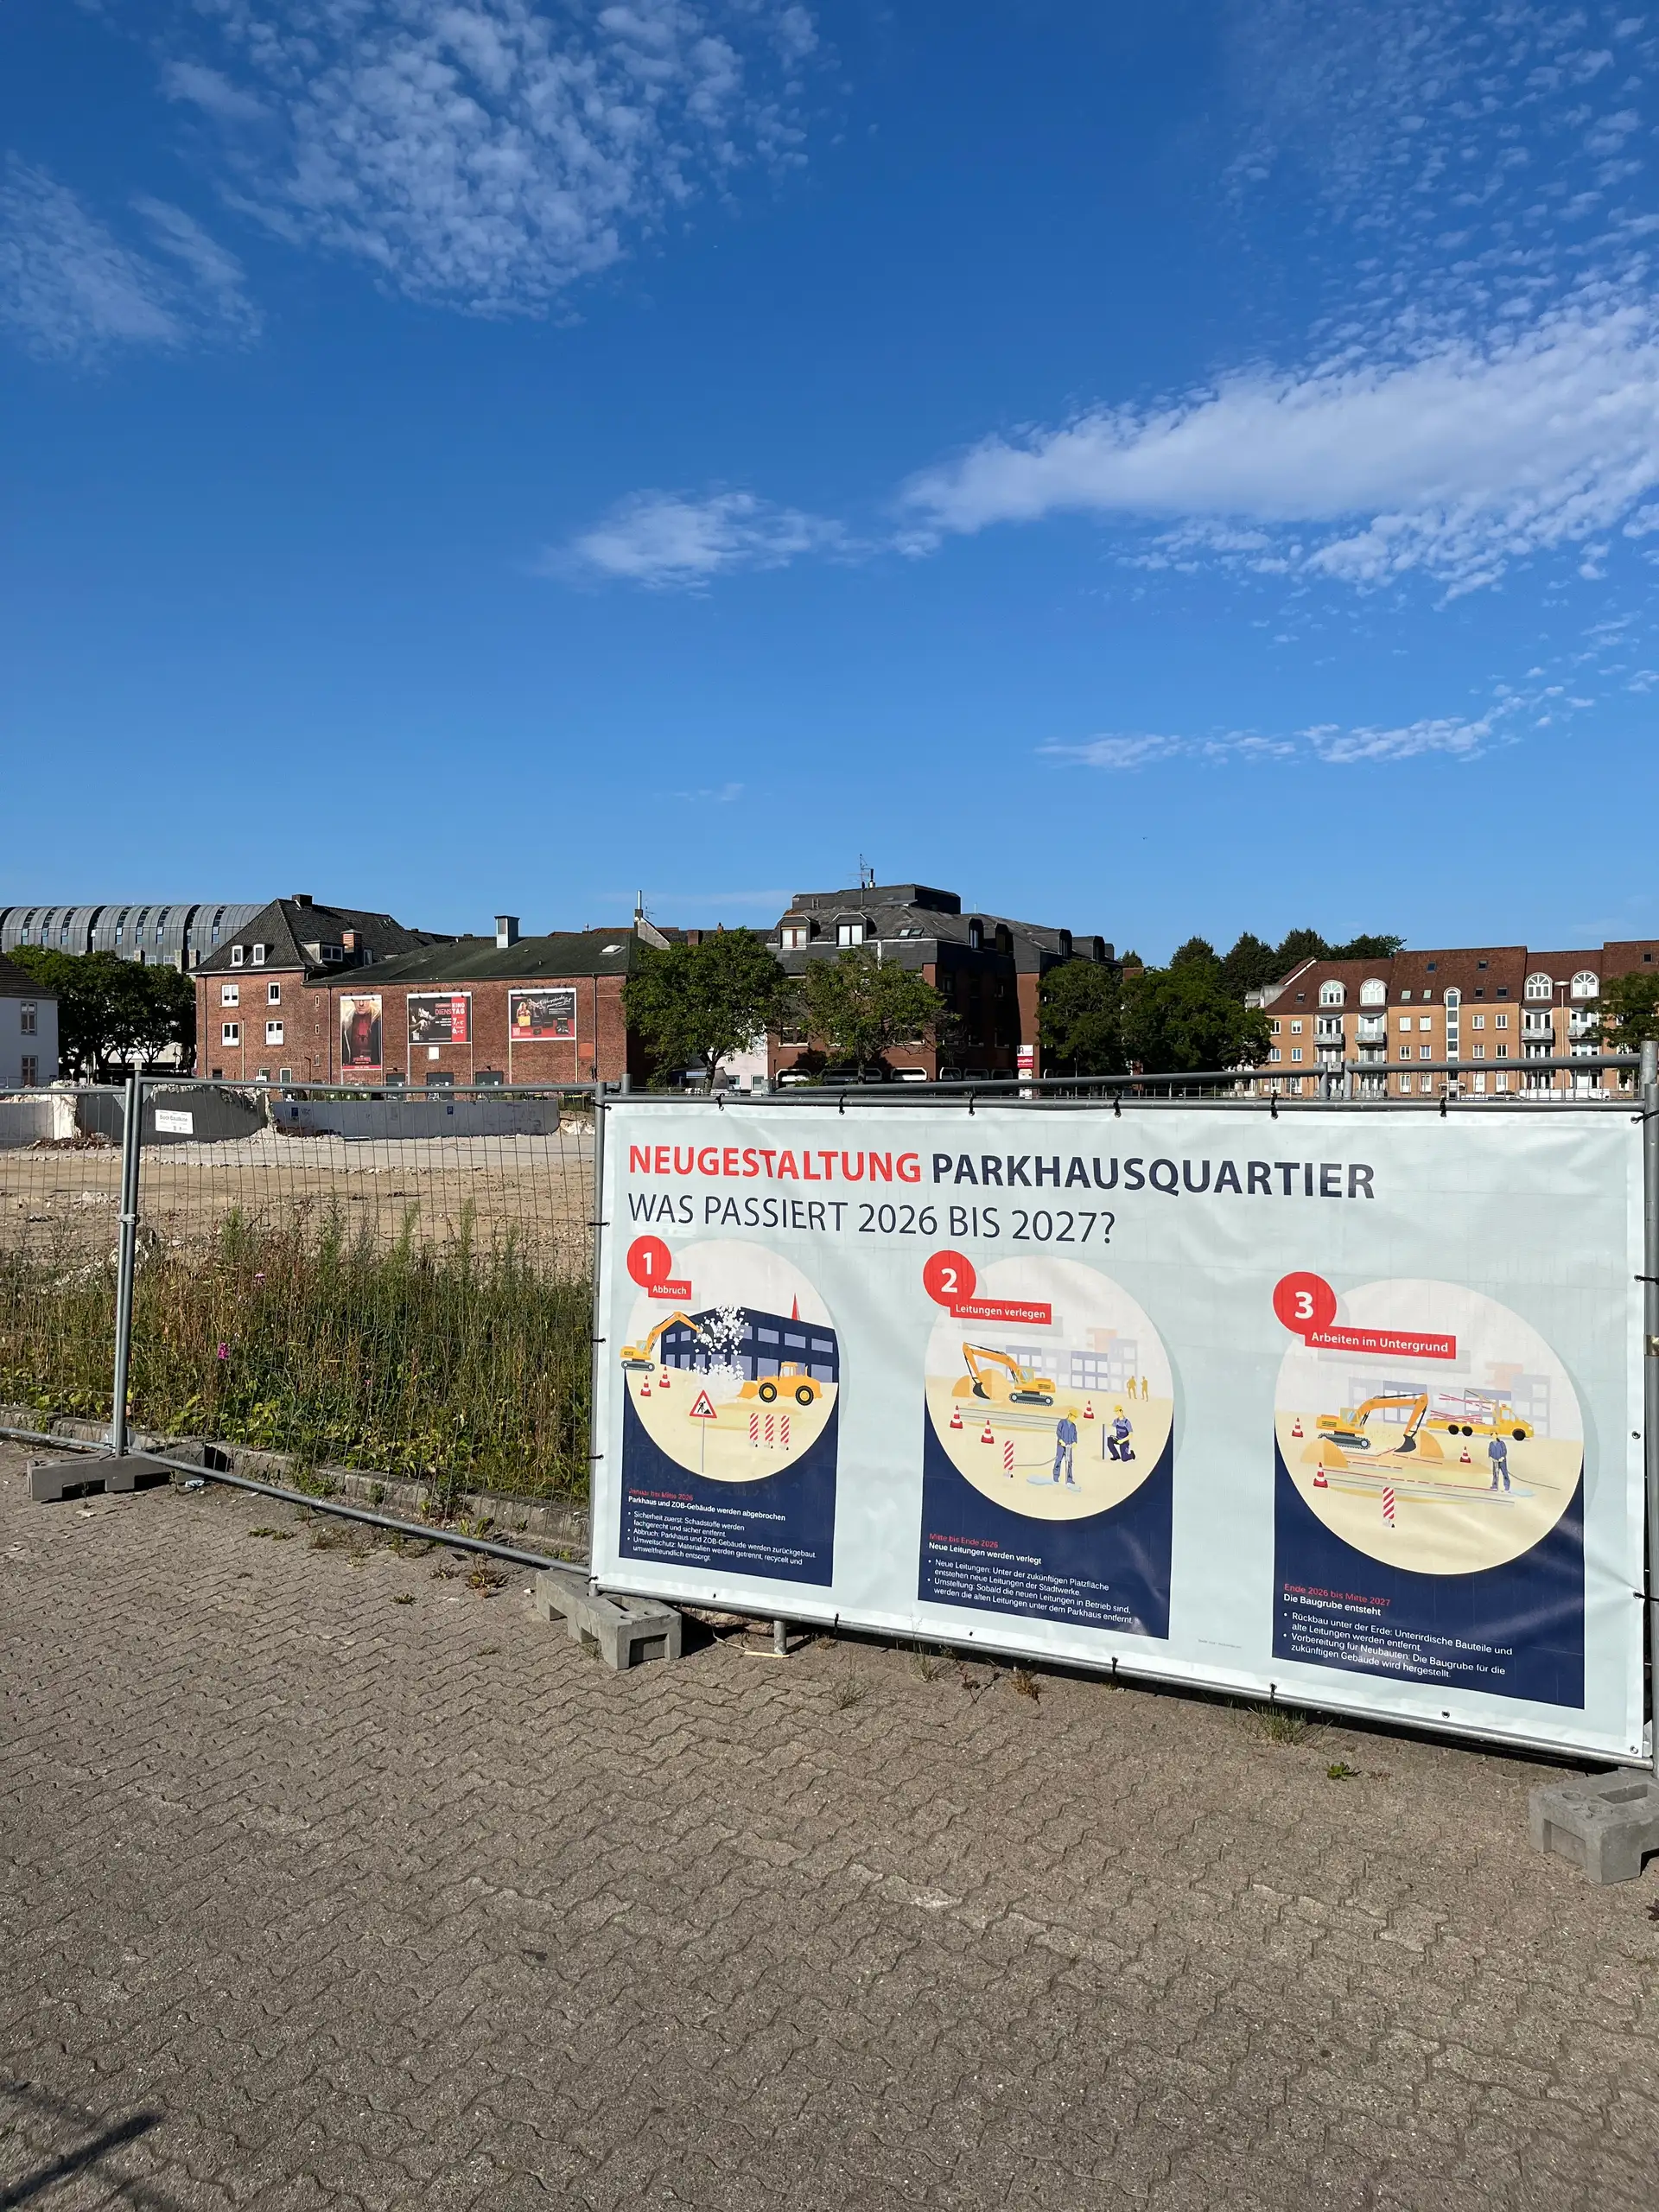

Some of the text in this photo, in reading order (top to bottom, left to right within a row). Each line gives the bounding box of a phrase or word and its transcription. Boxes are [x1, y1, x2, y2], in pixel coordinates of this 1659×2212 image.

[629, 1145, 1375, 1199] NEUGESTALTUNG PARKHAUSQUARTIER
[627, 1192, 693, 1224] WAS
[704, 1196, 849, 1231] PASSIERT
[858, 1203, 938, 1236] 2026
[950, 1205, 1001, 1238] BIS
[1011, 1209, 1116, 1244] 2027?
[643, 1251, 652, 1275] 1
[652, 1285, 687, 1294] Abbruch
[941, 1268, 957, 1294] 2
[956, 1304, 1046, 1320] Leitungen verlegen
[1294, 1291, 1313, 1319] 3
[1311, 1331, 1448, 1355] Arbeiten im Untergrund
[628, 1496, 657, 1505] Parkhaus
[671, 1502, 715, 1512] ZOB-Gebäude
[717, 1507, 741, 1516] werden
[743, 1510, 786, 1521] abgebrochen
[634, 1511, 663, 1521] Sicherheit
[684, 1517, 721, 1528] Schadstoffe
[721, 1522, 745, 1531] werden
[634, 1519, 669, 1529] fachgerecht
[632, 1546, 684, 1557] umweltfreundlich
[633, 1528, 660, 1536] Abbruch:
[660, 1531, 690, 1541] Parkhaus
[703, 1537, 747, 1548] ZOB-Gebäude
[748, 1543, 771, 1552] werden
[930, 1533, 947, 1541] Mitte
[982, 1540, 999, 1548] 2026
[677, 1542, 710, 1552] Materialien
[712, 1547, 734, 1555] werden
[764, 1554, 788, 1563] recycelt
[929, 1541, 1042, 1566] Neue Leitungen werden verlegt
[935, 1559, 954, 1567] Neue
[956, 1562, 991, 1573] Leitungen:
[992, 1567, 1012, 1576] Unter
[1027, 1573, 1068, 1585] zukünftigen
[1070, 1578, 1109, 1591] Platzfläche
[935, 1569, 969, 1580] entstehen
[989, 1576, 1025, 1588] Leitungen
[1026, 1581, 1037, 1590] der
[933, 1588, 960, 1597] werden
[973, 1593, 991, 1602] alten
[992, 1595, 1027, 1607] Leitungen
[1028, 1602, 1047, 1611] unter
[1067, 1607, 1101, 1619] Parkhaus
[976, 1584, 1001, 1593] Sobald
[1039, 1593, 1075, 1605] Leitungen
[1085, 1600, 1111, 1611] Betrieb
[1284, 1583, 1306, 1593] Ende
[1308, 1586, 1329, 1597] 2026
[1345, 1593, 1367, 1603] Mitte
[1370, 1597, 1391, 1606] 2027
[1284, 1593, 1381, 1616] Die Baugrube entsteht
[1292, 1612, 1512, 1656] Rückbau unter der Erde: Unterirdische Bauteile und
[1309, 1625, 1351, 1638] Leitungen
[1351, 1634, 1384, 1645] werden
[1387, 1640, 1422, 1652] entfernt.
[1291, 1633, 1505, 1675] Vorbereitung für Neubauten: Die Baugrube für die
[1291, 1643, 1452, 1678] zukünftigen Gebäude wird hergestellt.
